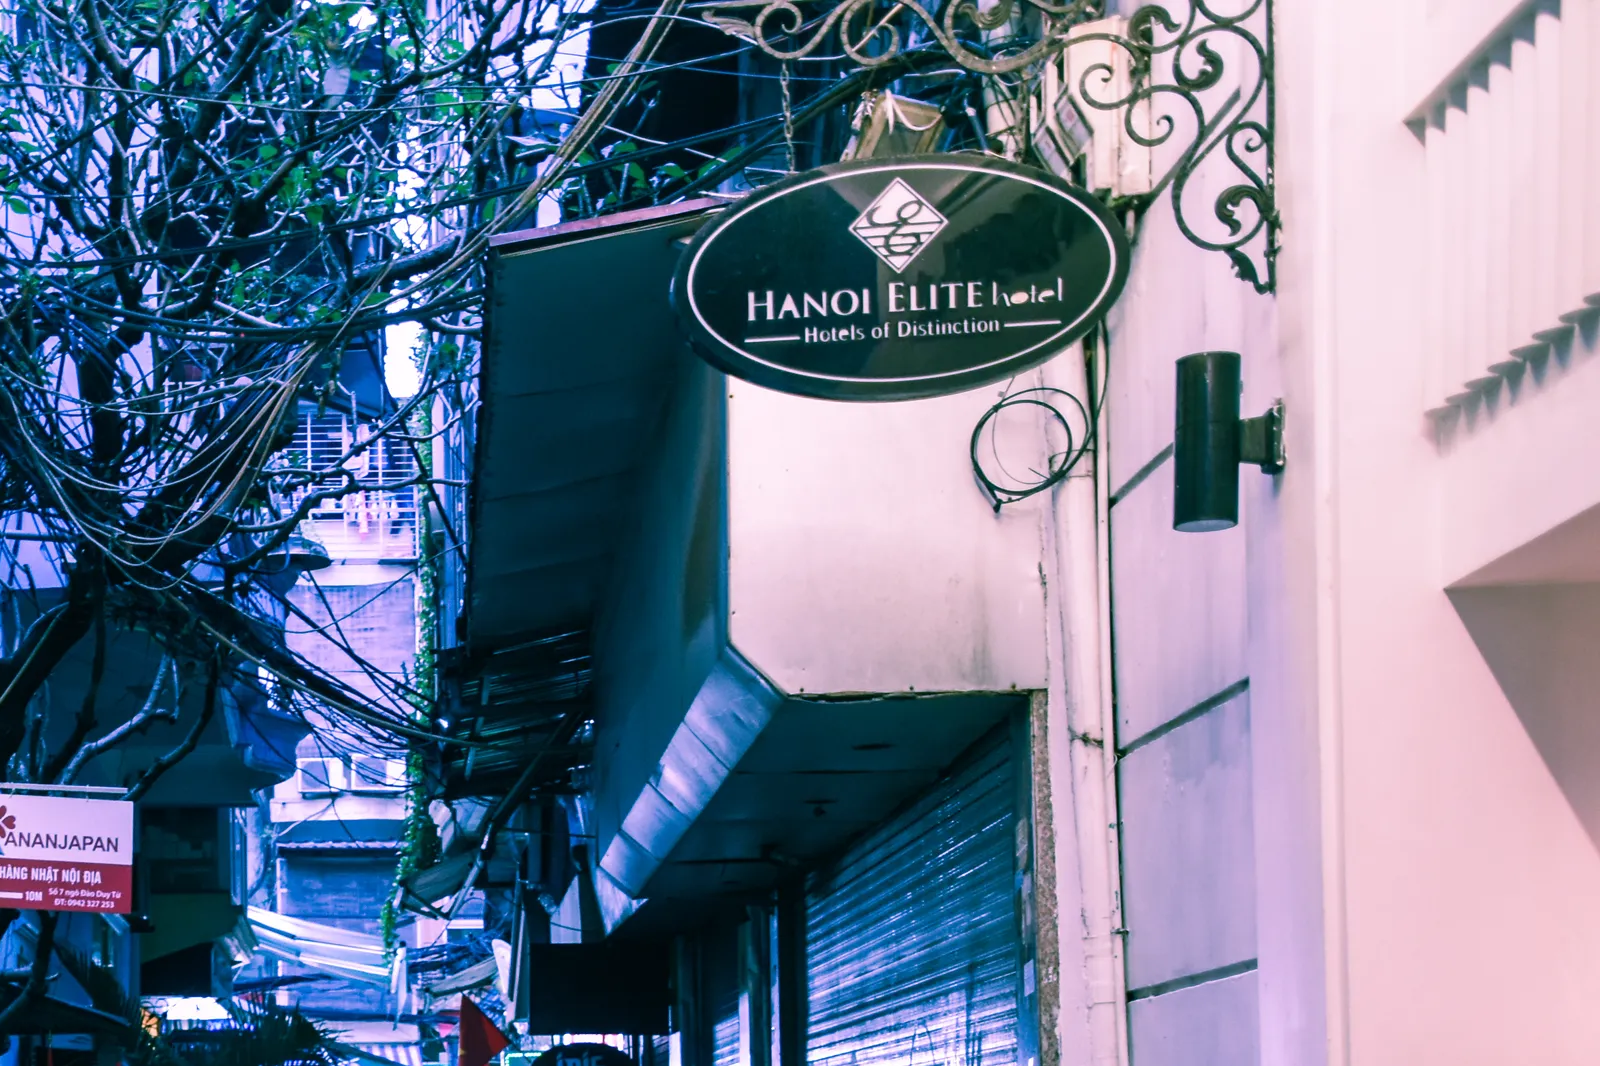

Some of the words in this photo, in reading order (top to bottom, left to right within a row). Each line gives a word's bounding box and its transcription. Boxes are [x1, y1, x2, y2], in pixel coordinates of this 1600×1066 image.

[747, 288, 870, 321] HANOI
[888, 281, 983, 312] ELITE
[992, 277, 1063, 307] hotel
[804, 325, 865, 344] Hotels
[871, 322, 890, 339] of
[897, 319, 1000, 338] Distinction
[0, 864, 28, 880] HÀNG
[31, 866, 58, 884] NHẬT
[62, 868, 80, 885] NỘI
[83, 871, 101, 886] ĐỊA
[25, 891, 42, 901] 10M
[96, 890, 110, 899] Duy
[54, 898, 67, 906] ĐT:
[67, 899, 85, 907] 0942
[87, 900, 100, 908] 327
[101, 901, 115, 909] 253
